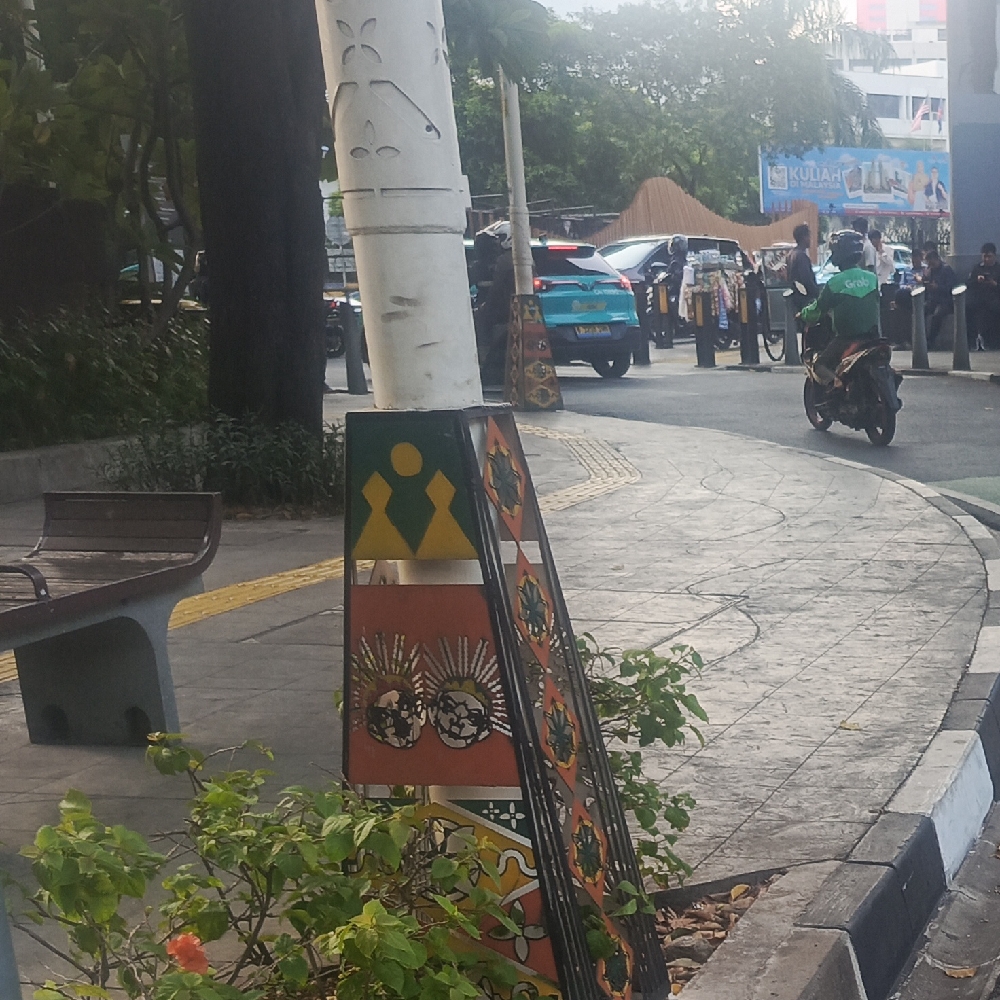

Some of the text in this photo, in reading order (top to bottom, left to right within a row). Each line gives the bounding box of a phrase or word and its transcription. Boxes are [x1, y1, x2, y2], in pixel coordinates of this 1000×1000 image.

[789, 167, 841, 182] KULIAH
[800, 181, 841, 189] MALAYSIA
[845, 277, 869, 288] Grab
